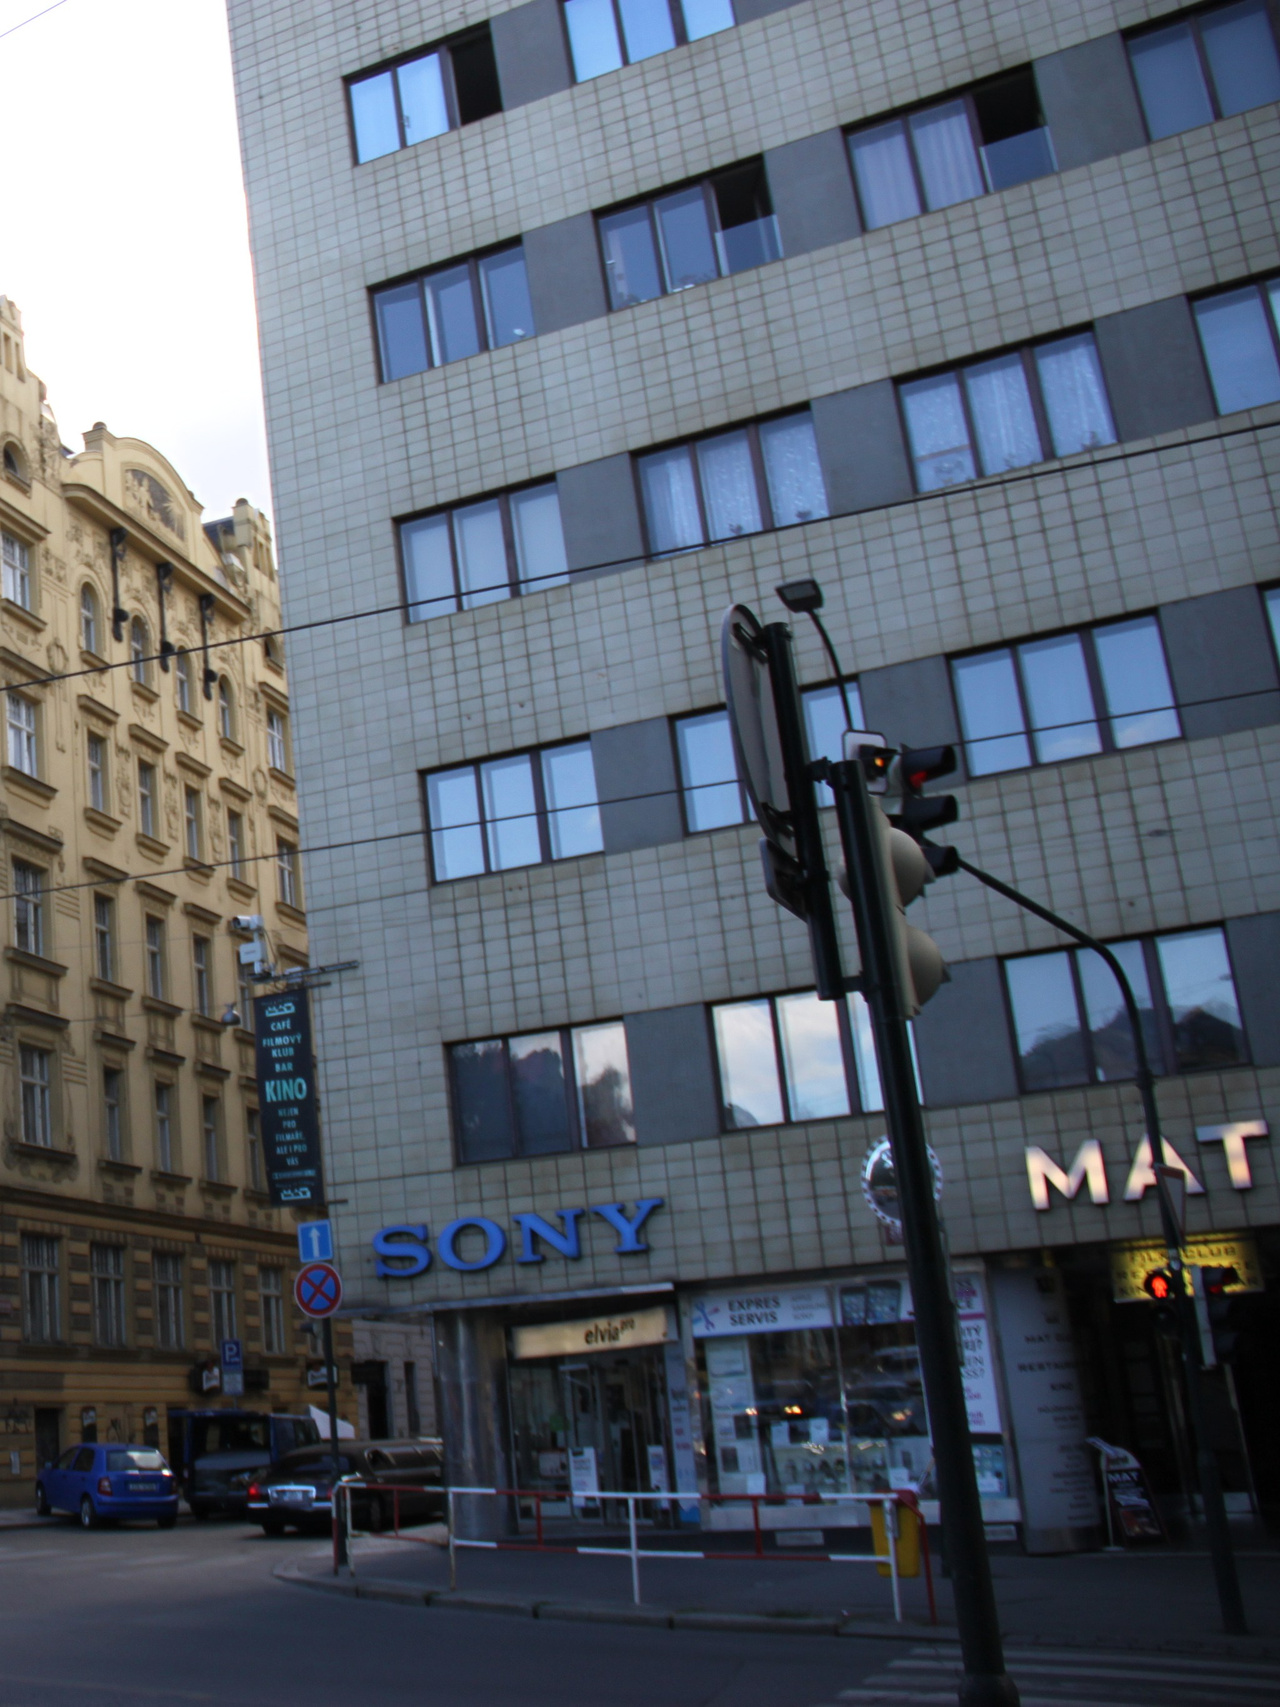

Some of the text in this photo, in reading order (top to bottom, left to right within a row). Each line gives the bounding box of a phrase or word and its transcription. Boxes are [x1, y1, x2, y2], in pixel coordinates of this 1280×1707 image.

[270, 1017, 292, 1032] CAFÉ
[262, 1032, 302, 1048] FILMOVÝ
[272, 1047, 295, 1058] KLUB
[275, 1062, 294, 1073] BAR
[265, 1077, 308, 1103] KINO
[1024, 1119, 1269, 1211] MAT
[373, 1197, 664, 1279] SONY
[728, 1295, 781, 1312] EXPRES
[729, 1311, 778, 1327] SERVIS
